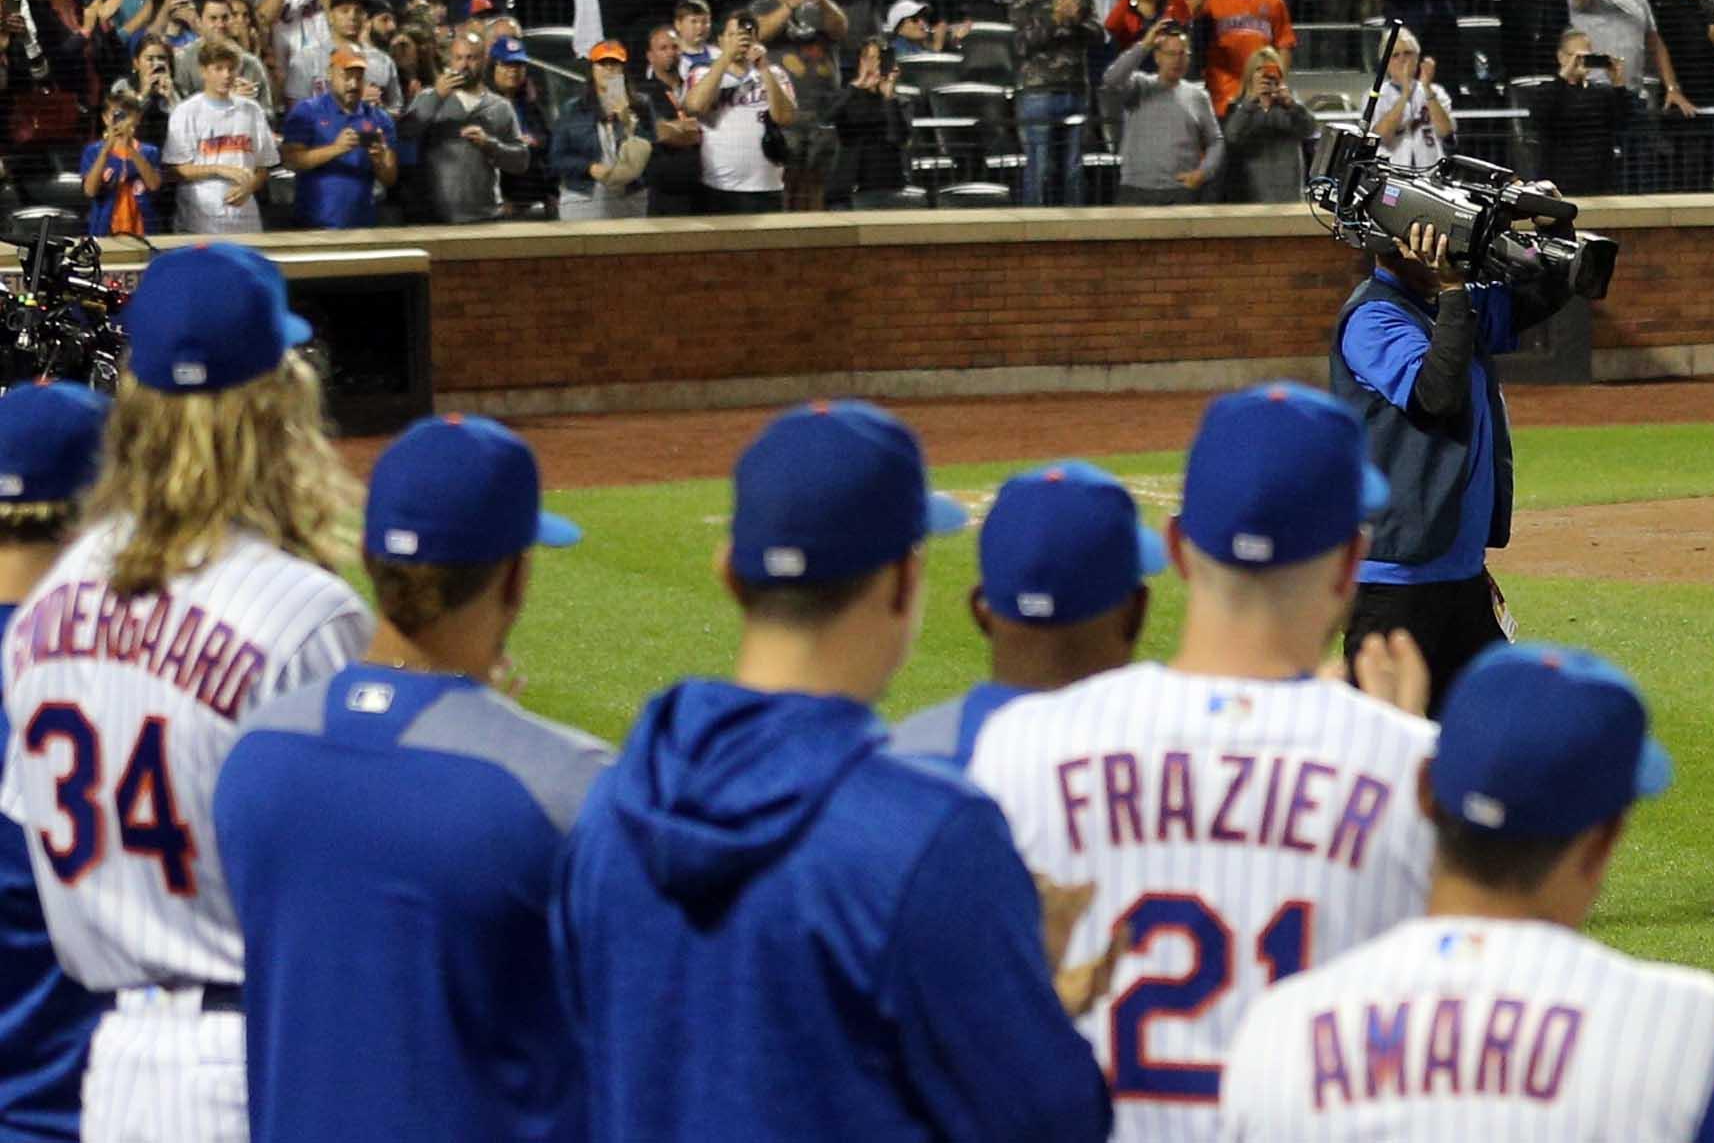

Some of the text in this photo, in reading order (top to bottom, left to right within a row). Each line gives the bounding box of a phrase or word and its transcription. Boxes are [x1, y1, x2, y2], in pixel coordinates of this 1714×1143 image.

[25, 702, 198, 898] 34
[1056, 752, 1393, 870] FRAZIER
[1308, 997, 1588, 1113] AMARO
